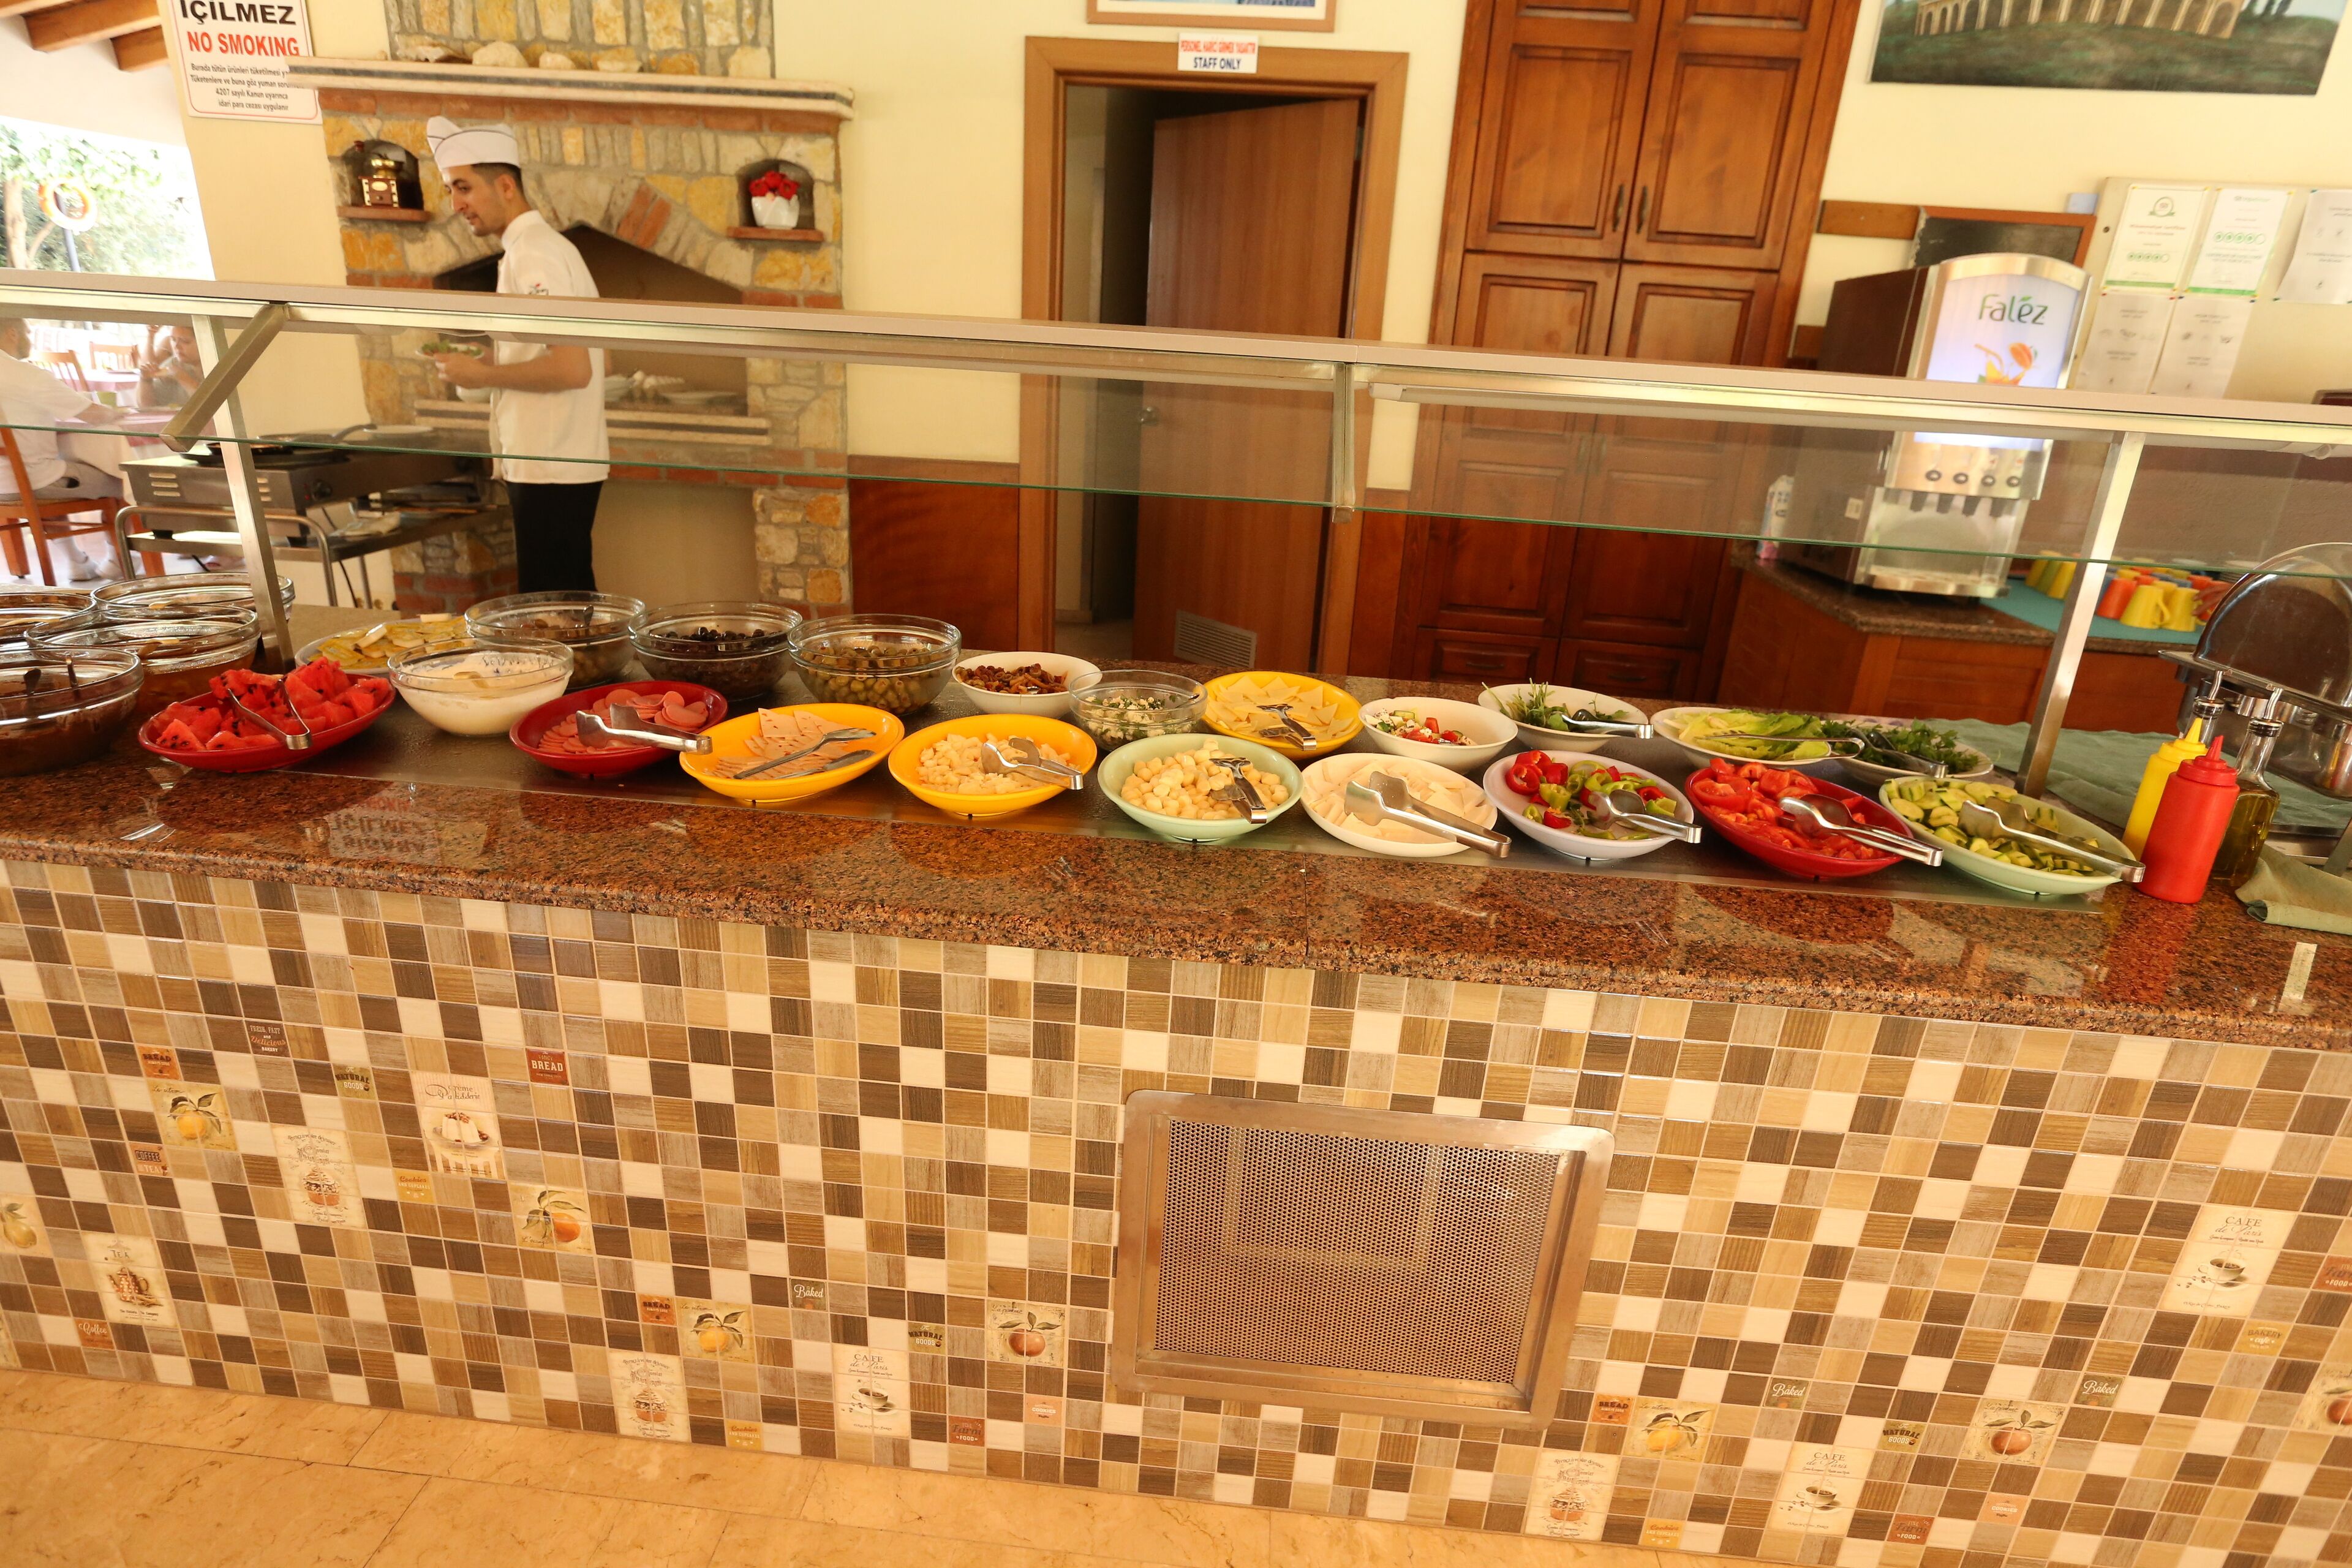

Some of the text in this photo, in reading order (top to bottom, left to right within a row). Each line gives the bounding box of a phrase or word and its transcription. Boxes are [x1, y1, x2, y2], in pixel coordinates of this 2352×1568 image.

[187, 31, 300, 57] NO SMOKING
[1194, 57, 1242, 70] STAFF ONLY
[251, 1035, 287, 1047] Delicious
[143, 1054, 171, 1062] BREAD
[531, 1060, 564, 1072] BREAD
[335, 1073, 370, 1084] NATURAL
[135, 1150, 162, 1163] COFFEE
[794, 1284, 824, 1298] Baked
[78, 1322, 107, 1335] Coffee
[2248, 1330, 2282, 1338] BAKERY
[908, 1331, 943, 1341] NATURAL
[1772, 1383, 1806, 1396] Baked
[2082, 1380, 2119, 1394] Baked
[1883, 1429, 1920, 1439] NATURAL
